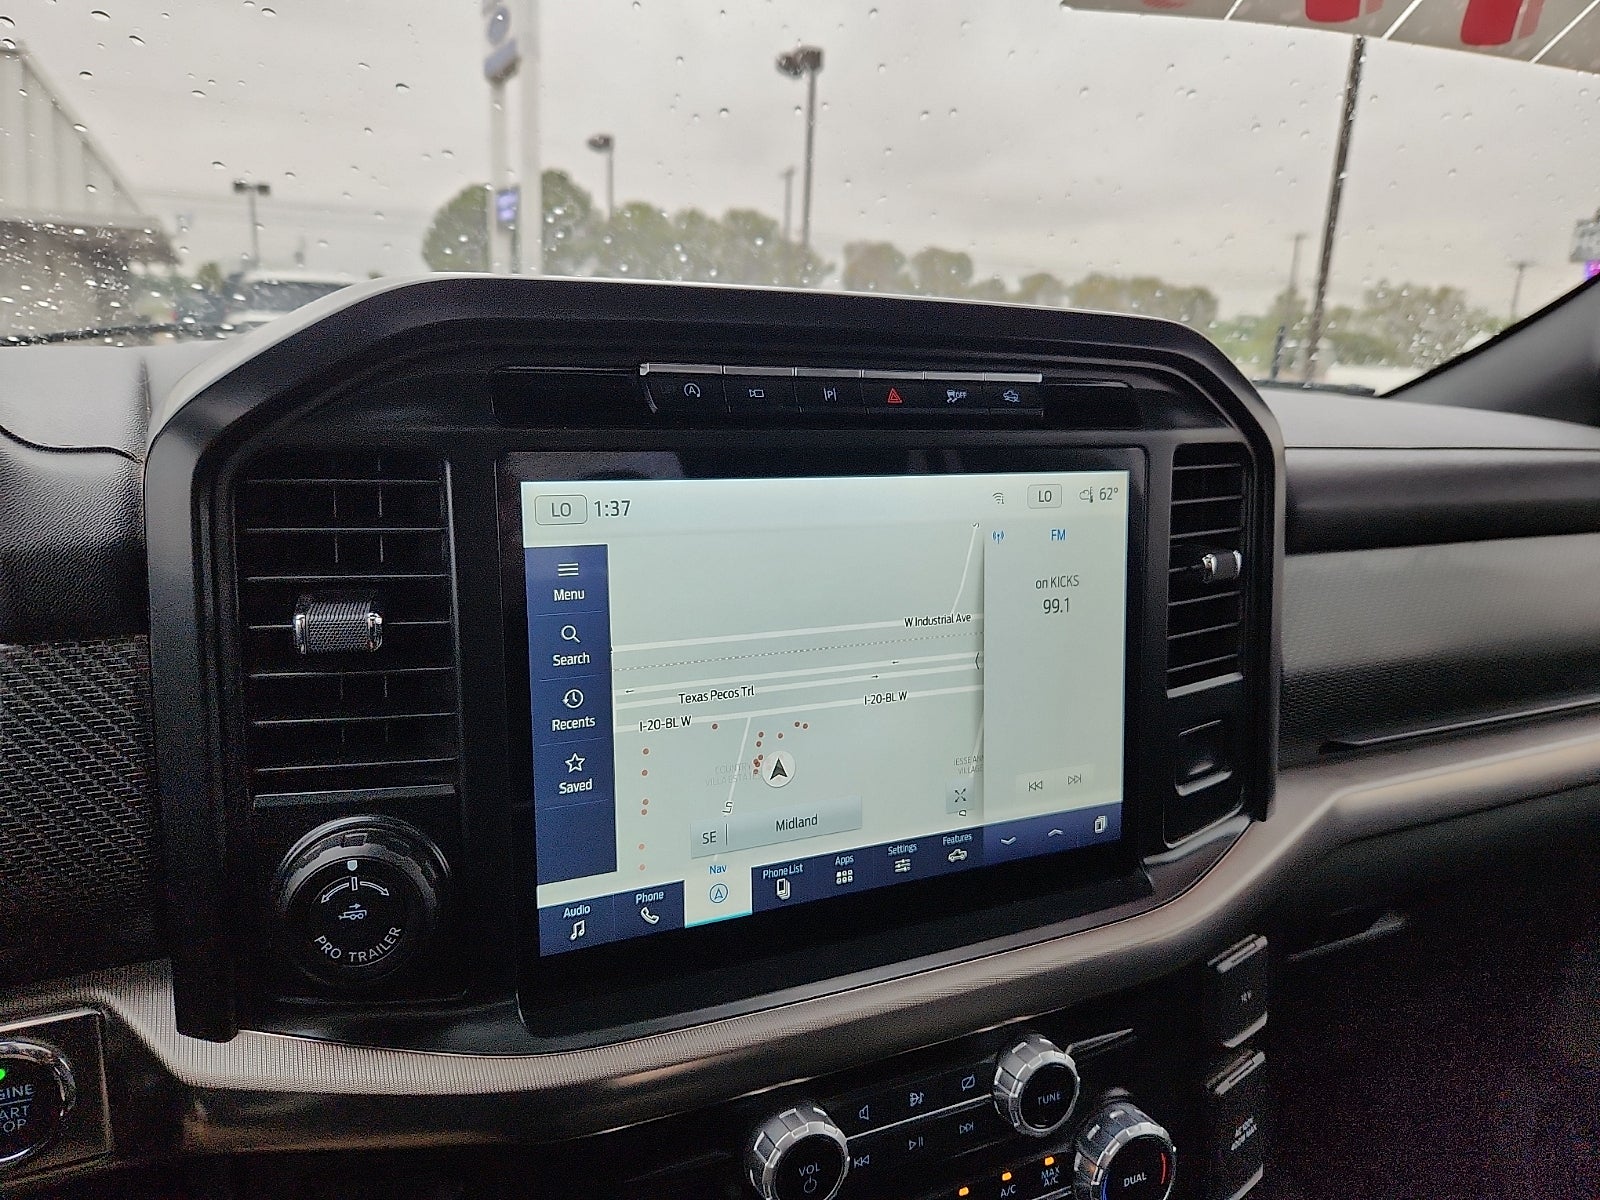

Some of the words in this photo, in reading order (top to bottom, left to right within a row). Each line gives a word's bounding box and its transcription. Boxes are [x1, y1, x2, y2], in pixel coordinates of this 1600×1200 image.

[1038, 490, 1052, 503] LO
[1099, 487, 1119, 501] 62°
[551, 502, 572, 518] LO
[594, 500, 631, 517] 1:37
[1051, 529, 1066, 542] FM
[1035, 579, 1048, 590] on
[1050, 575, 1080, 588] KICKS
[554, 589, 585, 601] Menu
[1043, 598, 1070, 614] 99.1
[904, 617, 914, 627] W
[915, 614, 954, 627] Industrial
[955, 613, 971, 624] Ave
[552, 652, 590, 666] Search
[678, 692, 709, 704] Texas
[710, 688, 740, 701] Pecos
[741, 686, 755, 697] Trl
[864, 693, 897, 705] I-20-BL
[898, 691, 908, 702] W
[552, 716, 596, 731] Recents
[639, 718, 679, 732] I-20-BL
[681, 716, 692, 726] W
[558, 778, 593, 794] Saved
[775, 814, 818, 832] Midland
[702, 831, 717, 844] SE
[942, 832, 972, 845] Features
[887, 842, 918, 856] Settings
[835, 855, 854, 867] Apps
[709, 864, 727, 874] Nav
[762, 867, 788, 879] Phone
[789, 864, 804, 876] List
[635, 890, 664, 904] Phone
[563, 904, 591, 918] Audio
[314, 935, 342, 959] PRO
[349, 926, 402, 962] TRAILER
[1037, 1091, 1061, 1105] TUNE
[798, 1163, 821, 1177] VOL
[1041, 1166, 1061, 1180] MAX
[1043, 1176, 1060, 1188] A/C
[1123, 1171, 1148, 1188] DUAL
[1000, 1184, 1017, 1198] A/C
